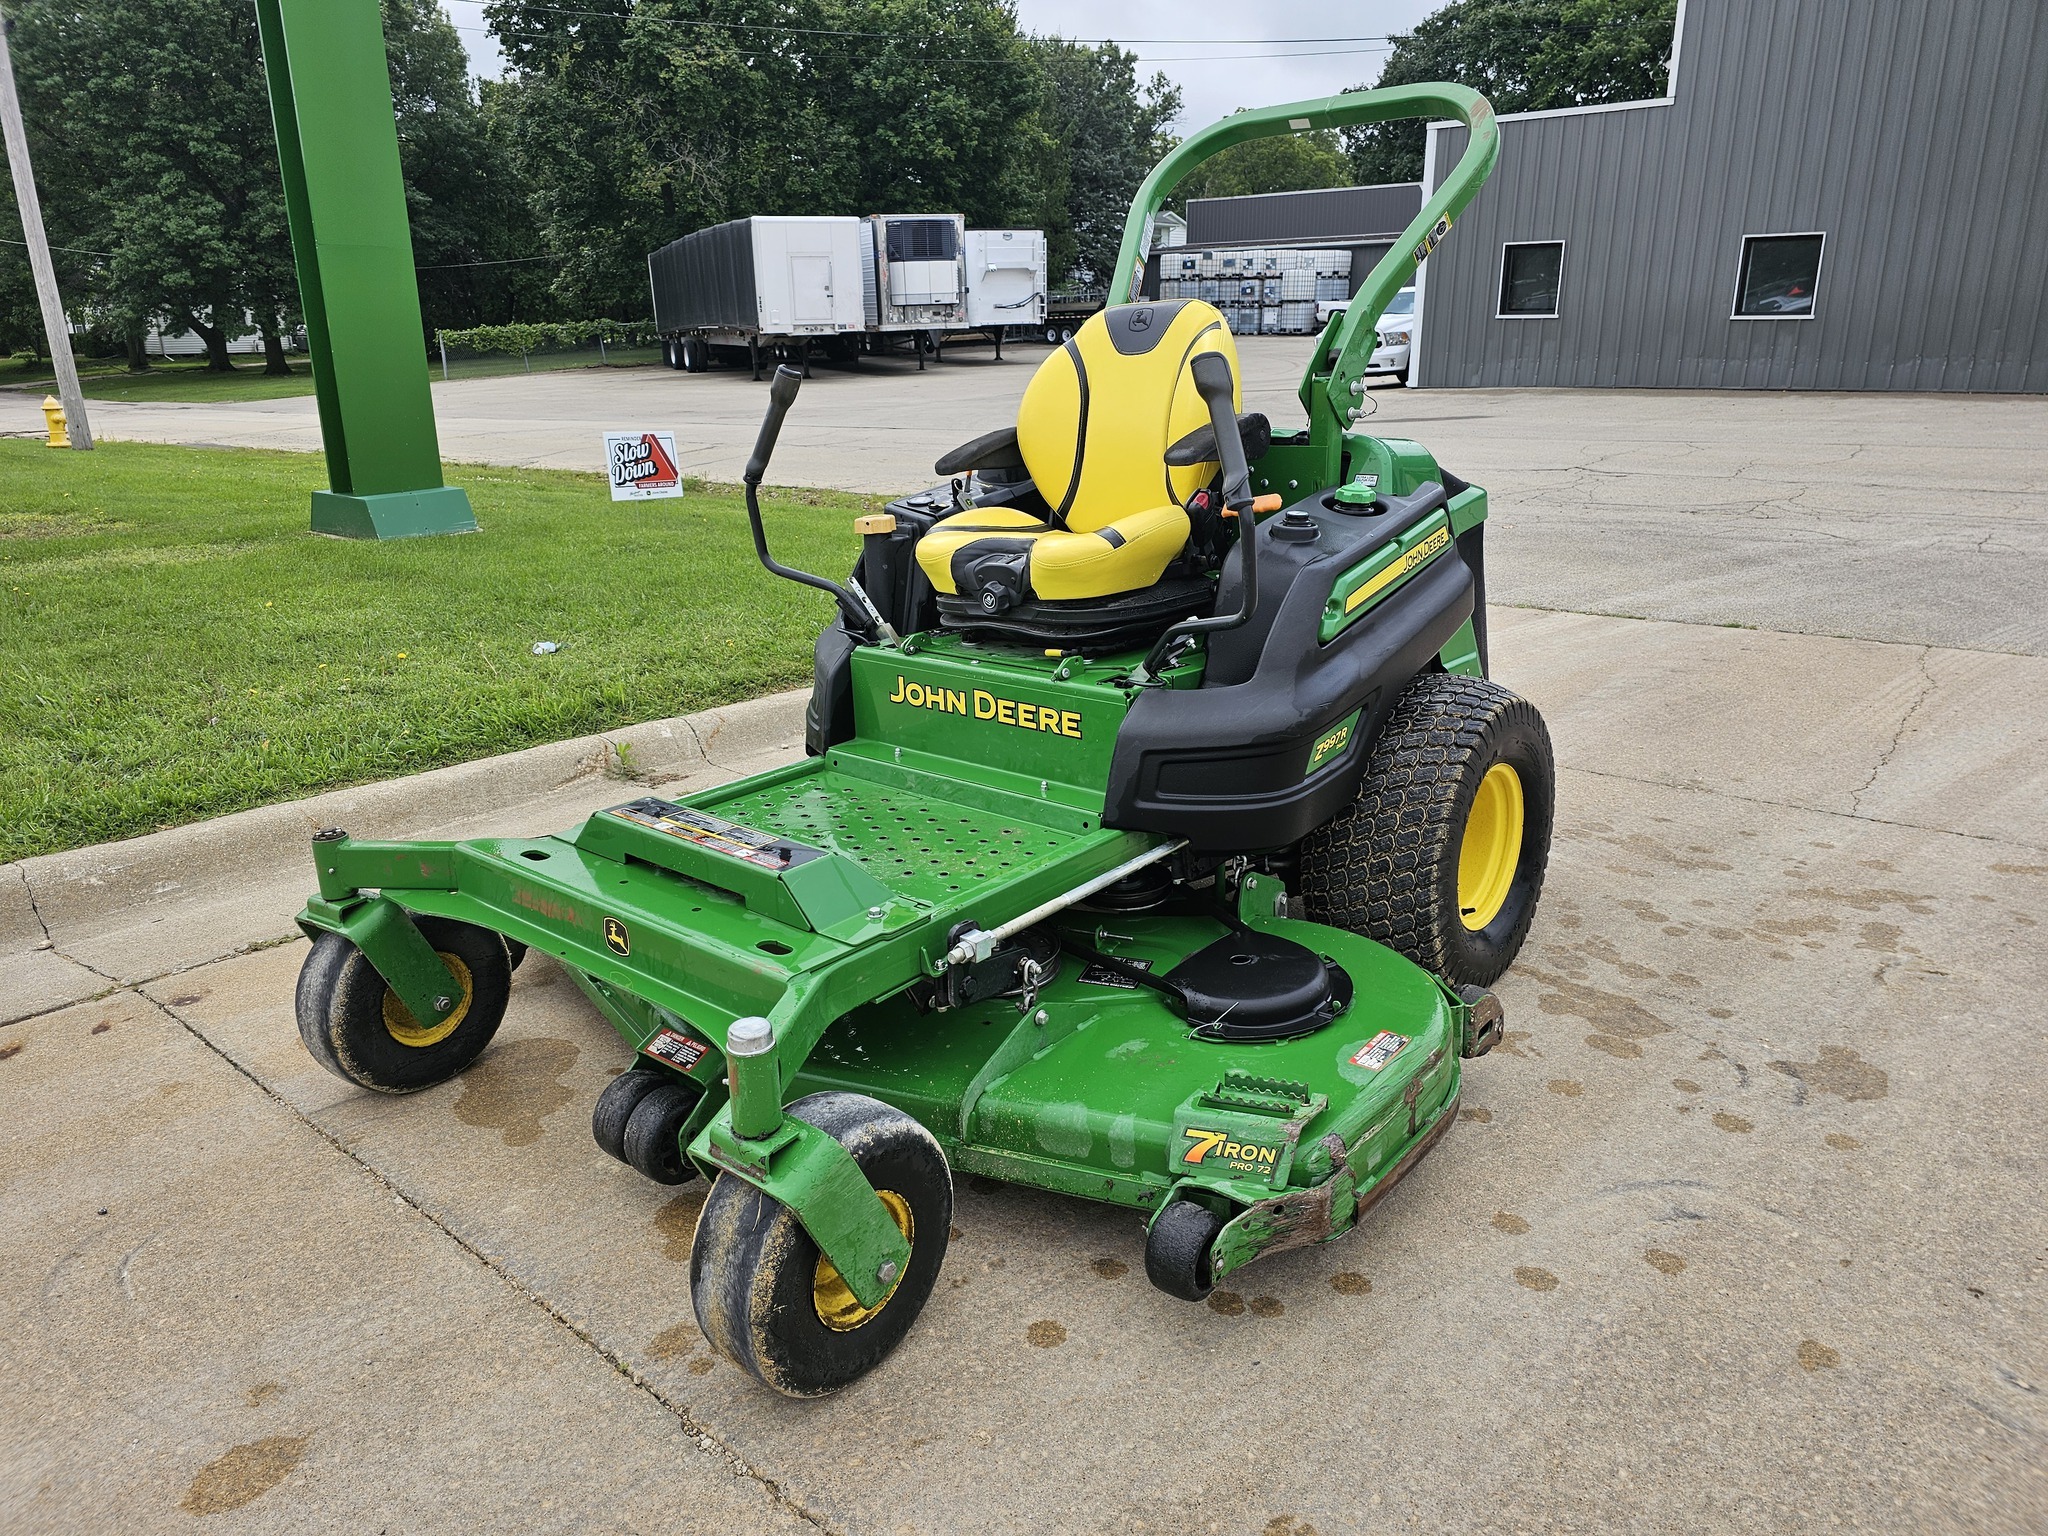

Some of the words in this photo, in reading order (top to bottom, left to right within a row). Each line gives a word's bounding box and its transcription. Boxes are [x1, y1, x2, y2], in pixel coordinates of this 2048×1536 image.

[614, 442, 650, 464] Slow
[612, 460, 656, 485] Down
[1403, 550, 1424, 574] JOHN
[1423, 531, 1446, 557] DEERE
[889, 675, 967, 716] JOHN
[973, 689, 1083, 740] DEERE
[1313, 726, 1348, 762] Z997R
[1229, 1161, 1254, 1173] PRO
[1257, 1164, 1272, 1175] 72
